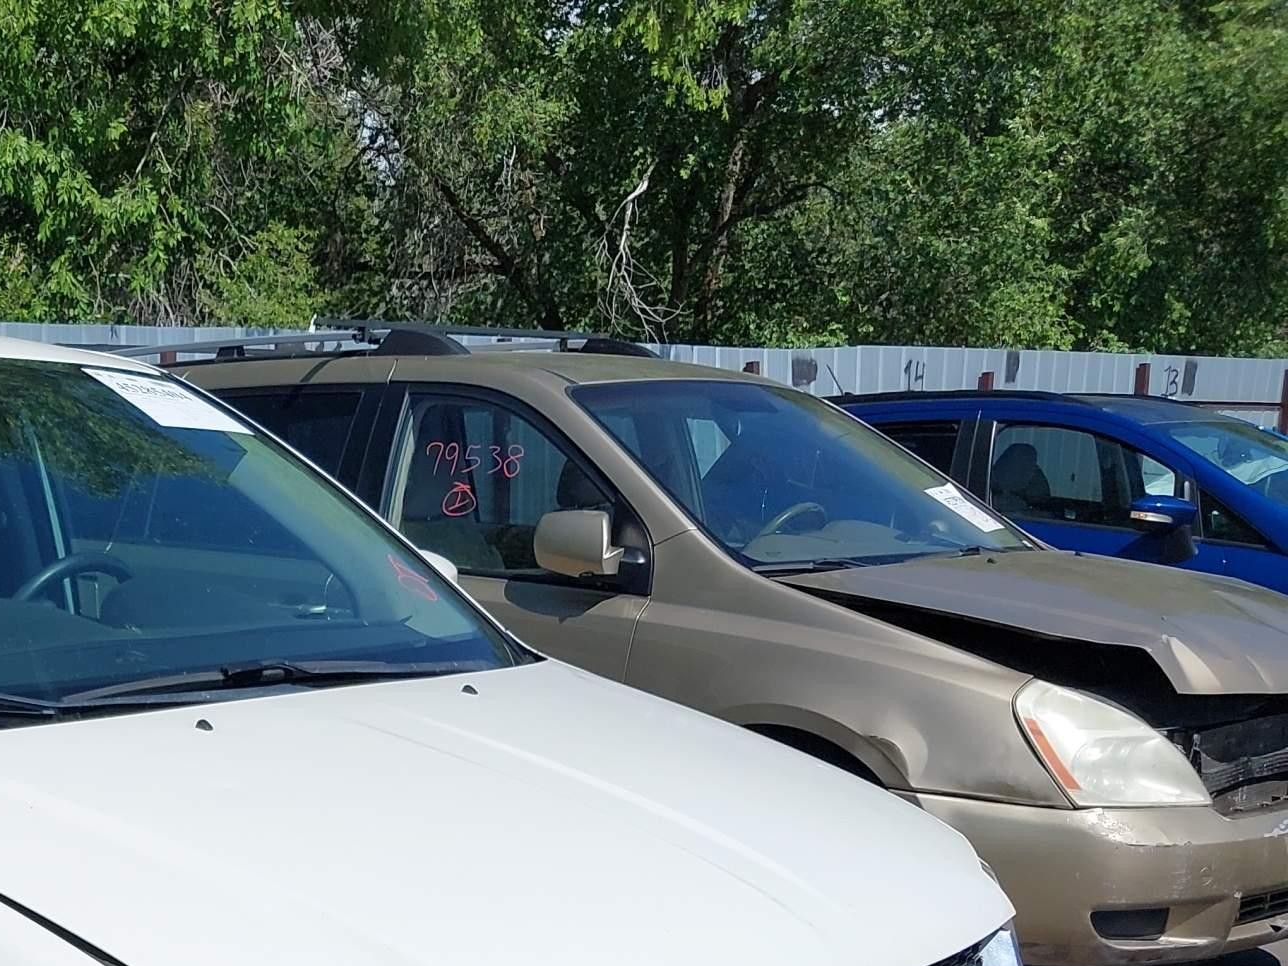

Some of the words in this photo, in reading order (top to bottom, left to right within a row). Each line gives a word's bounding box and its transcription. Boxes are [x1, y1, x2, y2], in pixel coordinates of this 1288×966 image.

[904, 359, 926, 392] 14
[1161, 365, 1179, 397] 13
[426, 441, 525, 478] 79538
